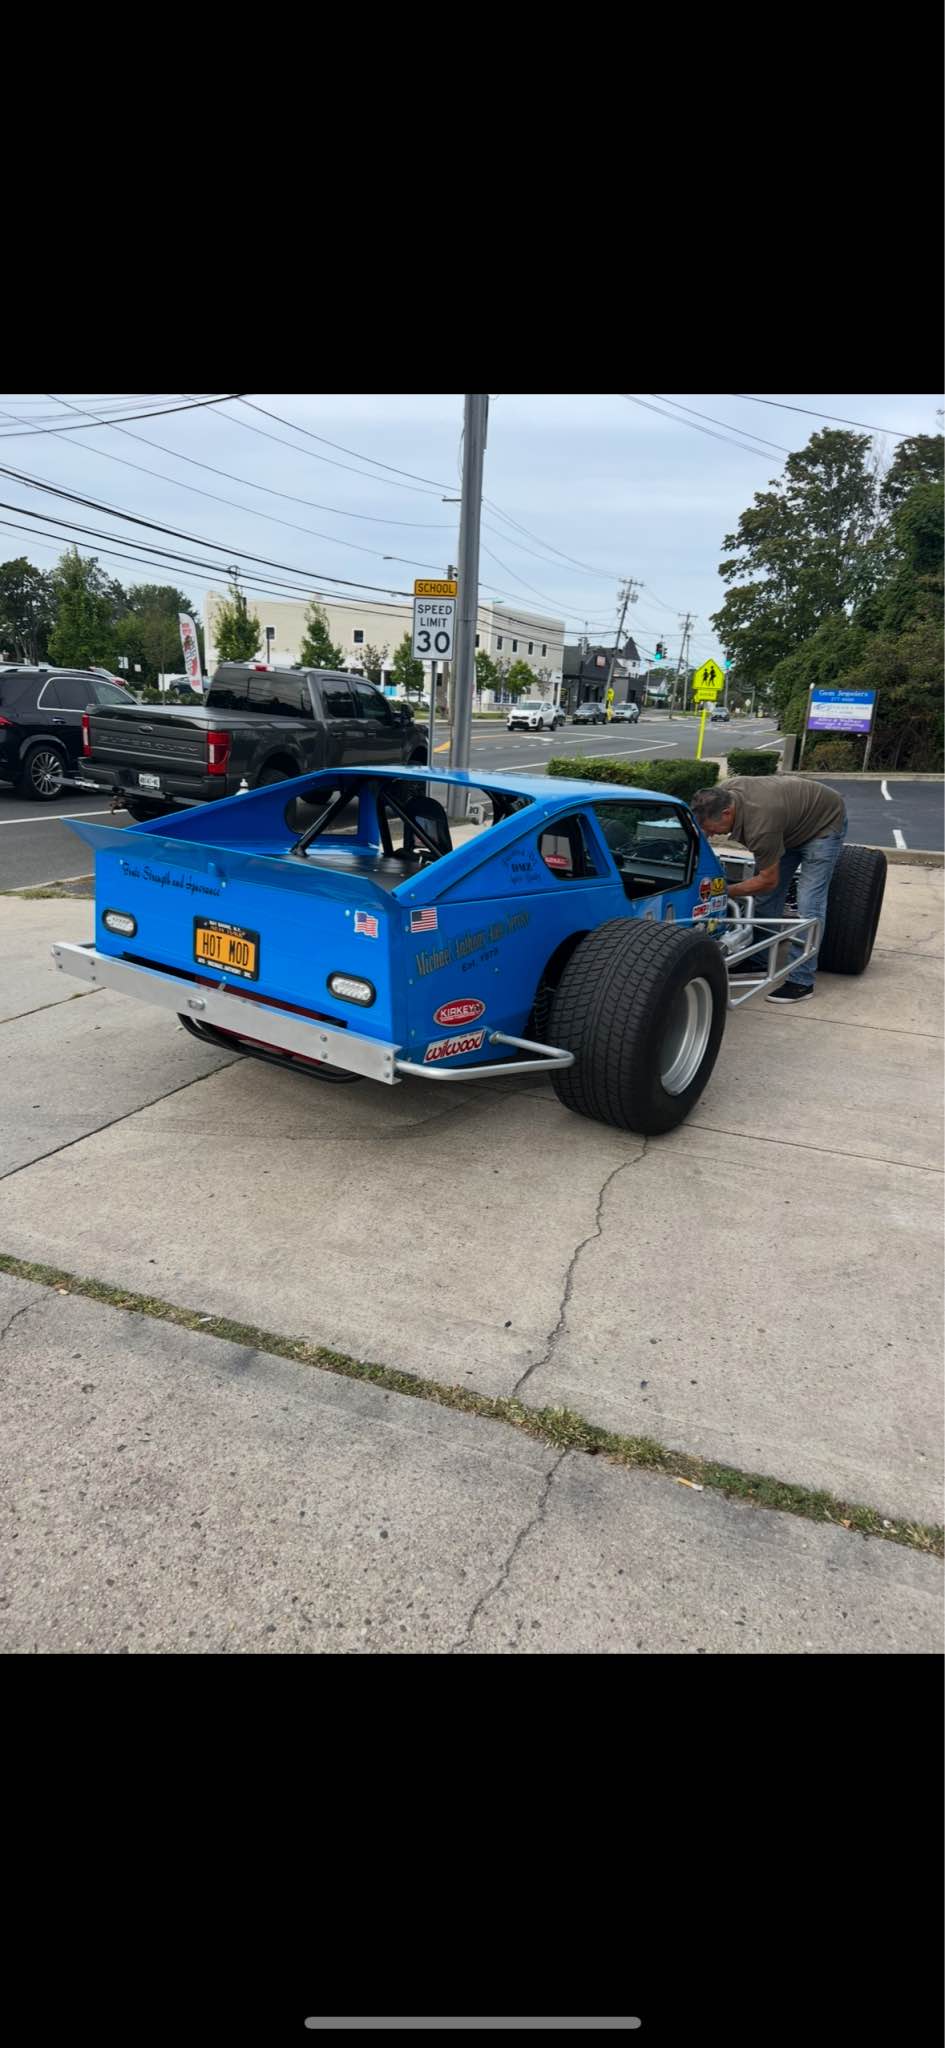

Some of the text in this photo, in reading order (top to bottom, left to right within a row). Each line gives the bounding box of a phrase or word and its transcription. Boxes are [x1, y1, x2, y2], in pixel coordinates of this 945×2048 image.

[417, 583, 454, 594] SCHOOL
[417, 604, 453, 615] SPEED
[420, 617, 448, 627] LIMIT
[416, 630, 450, 653] 30
[203, 932, 249, 966] HOT MOD
[440, 1003, 476, 1018] KIRKEY
